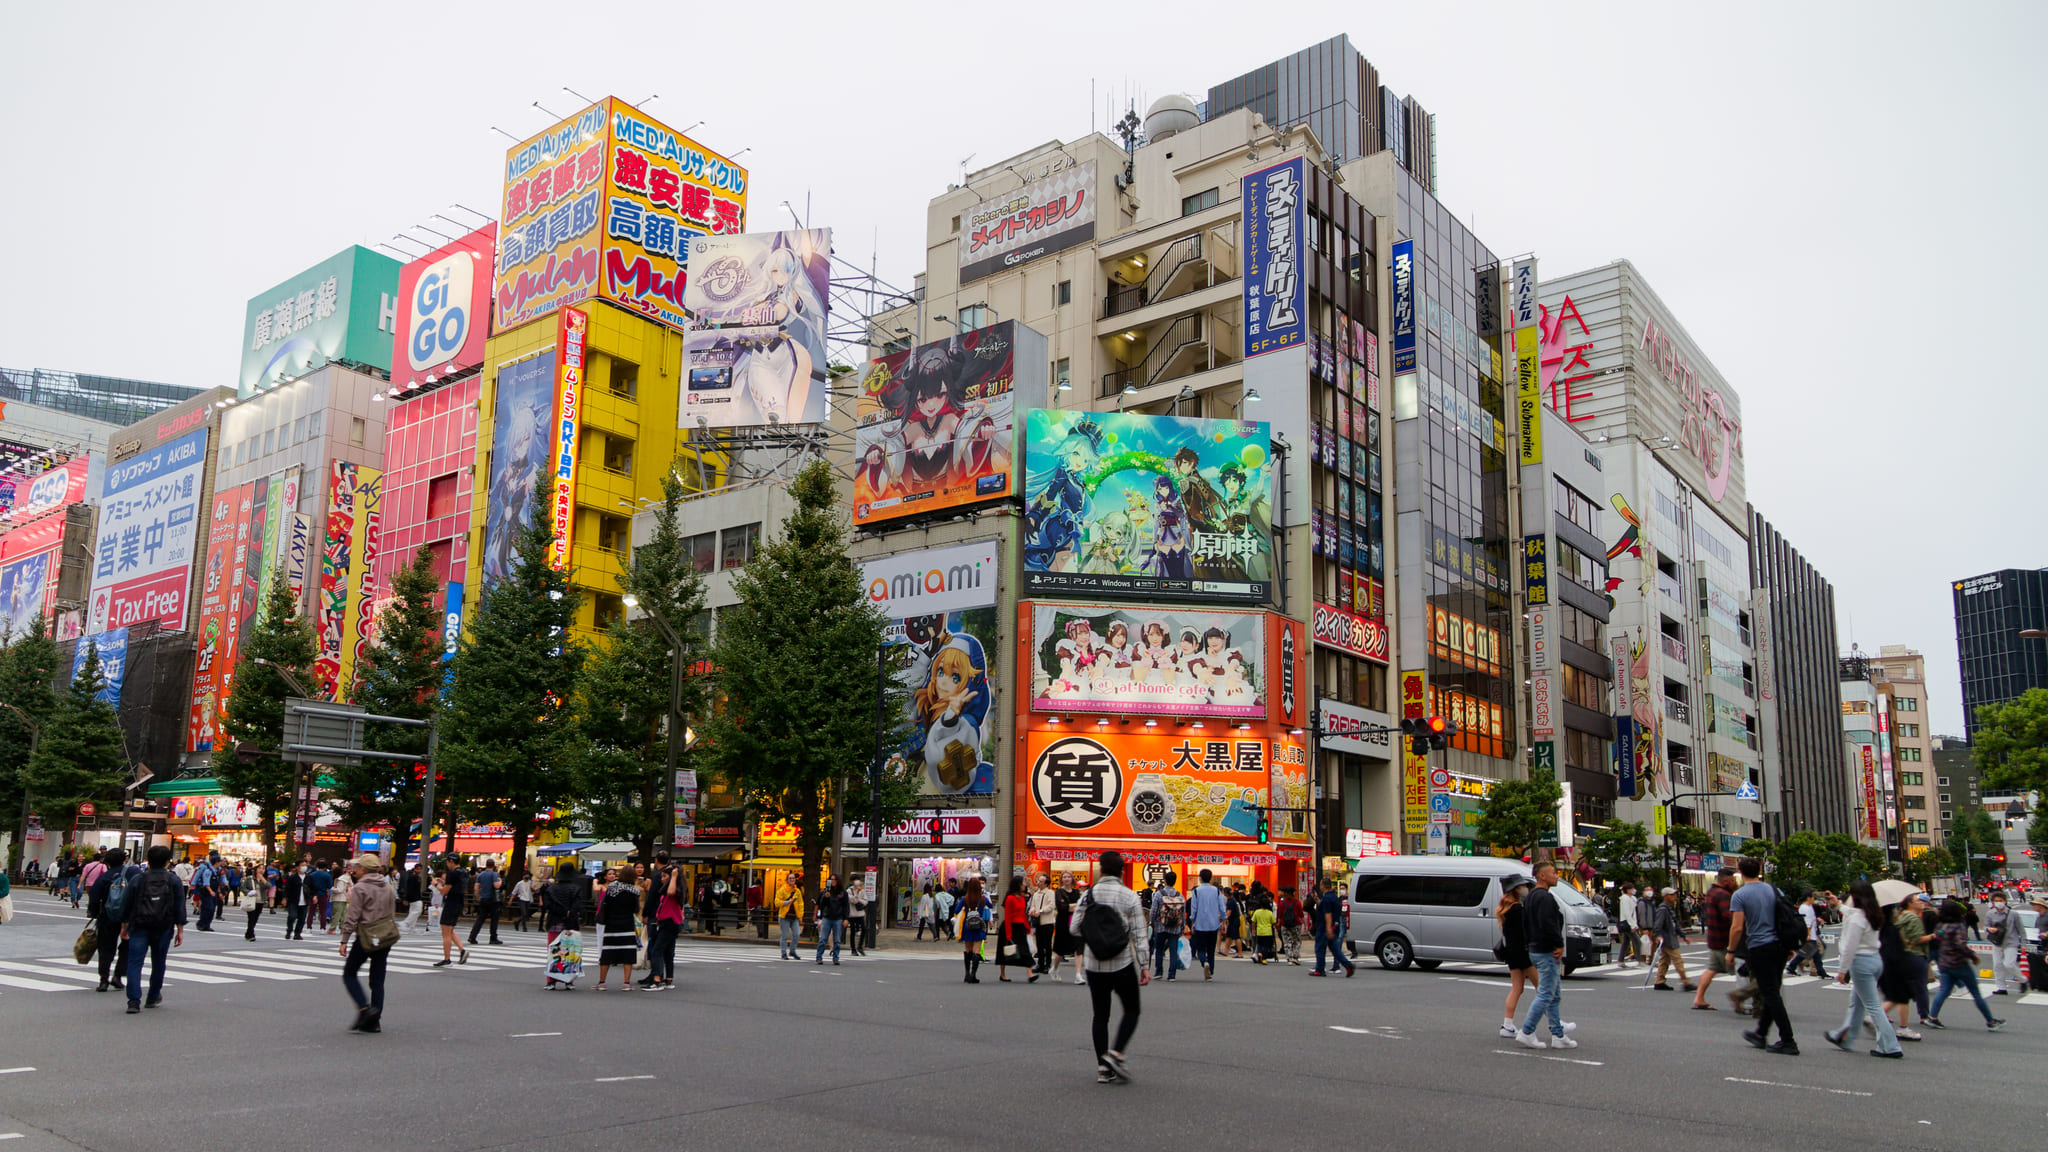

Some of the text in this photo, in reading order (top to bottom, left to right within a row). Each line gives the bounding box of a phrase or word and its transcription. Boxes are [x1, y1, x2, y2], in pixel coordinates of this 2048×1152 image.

[504, 139, 604, 226] 激安販売
[611, 145, 742, 235] 激安販売
[500, 186, 599, 276] 高額買取
[969, 189, 1085, 254] メイドカジノ
[498, 244, 597, 328] Mulan
[1249, 285, 1260, 336] 秋葉原店
[986, 377, 1009, 398] 初月
[1519, 356, 1531, 393] Yellow
[1521, 400, 1534, 459] Submarine
[121, 441, 197, 483] ソフマップ AKIBA
[105, 473, 194, 525] アミューズメント館
[214, 500, 229, 522] 4F
[96, 517, 166, 580] 営業中
[1324, 534, 1337, 556] 5F
[1435, 537, 1473, 577] 秋葉館
[206, 571, 221, 593] 3F
[869, 561, 981, 602] amiami
[1043, 576, 1067, 584] PS5
[1073, 577, 1098, 585] PS4
[1101, 579, 1131, 588] Windows
[1500, 578, 1509, 593] 5F
[1527, 539, 1546, 604] 秋葉館
[113, 590, 180, 626] Tax Free
[1313, 606, 1387, 657] メイドカジノ
[1534, 613, 1546, 668] amiami
[198, 652, 213, 672] 2F
[1178, 683, 1208, 697] cafe
[1535, 677, 1550, 727] あみあみ
[1127, 740, 1264, 772] チケット 大黒屋
[1622, 734, 1631, 780] GALLERIA
[1043, 752, 1112, 817] 質
[1417, 766, 1427, 805] FREE
[1434, 773, 1447, 783] 40
